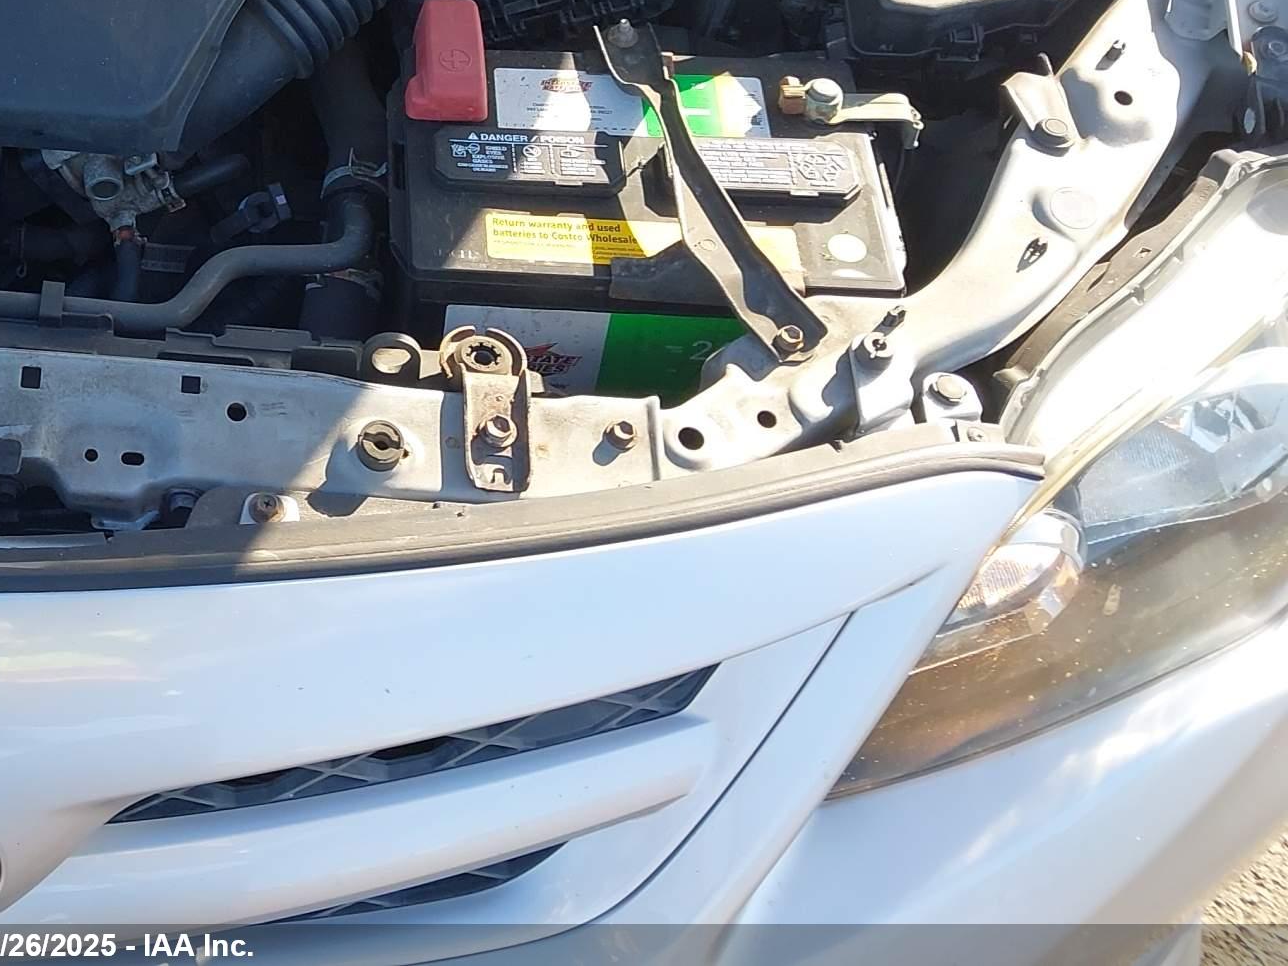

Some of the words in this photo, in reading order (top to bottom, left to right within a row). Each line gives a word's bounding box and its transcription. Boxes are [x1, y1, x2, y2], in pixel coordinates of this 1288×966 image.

[480, 133, 528, 142] DANGER
[539, 135, 585, 144] POISON
[492, 217, 526, 227] Return
[528, 220, 573, 232] warranty
[575, 222, 594, 231] and
[597, 223, 621, 232] used
[493, 228, 537, 239] batteries
[539, 230, 549, 239] to
[551, 231, 583, 241] Costco
[585, 232, 638, 244] Wholesale
